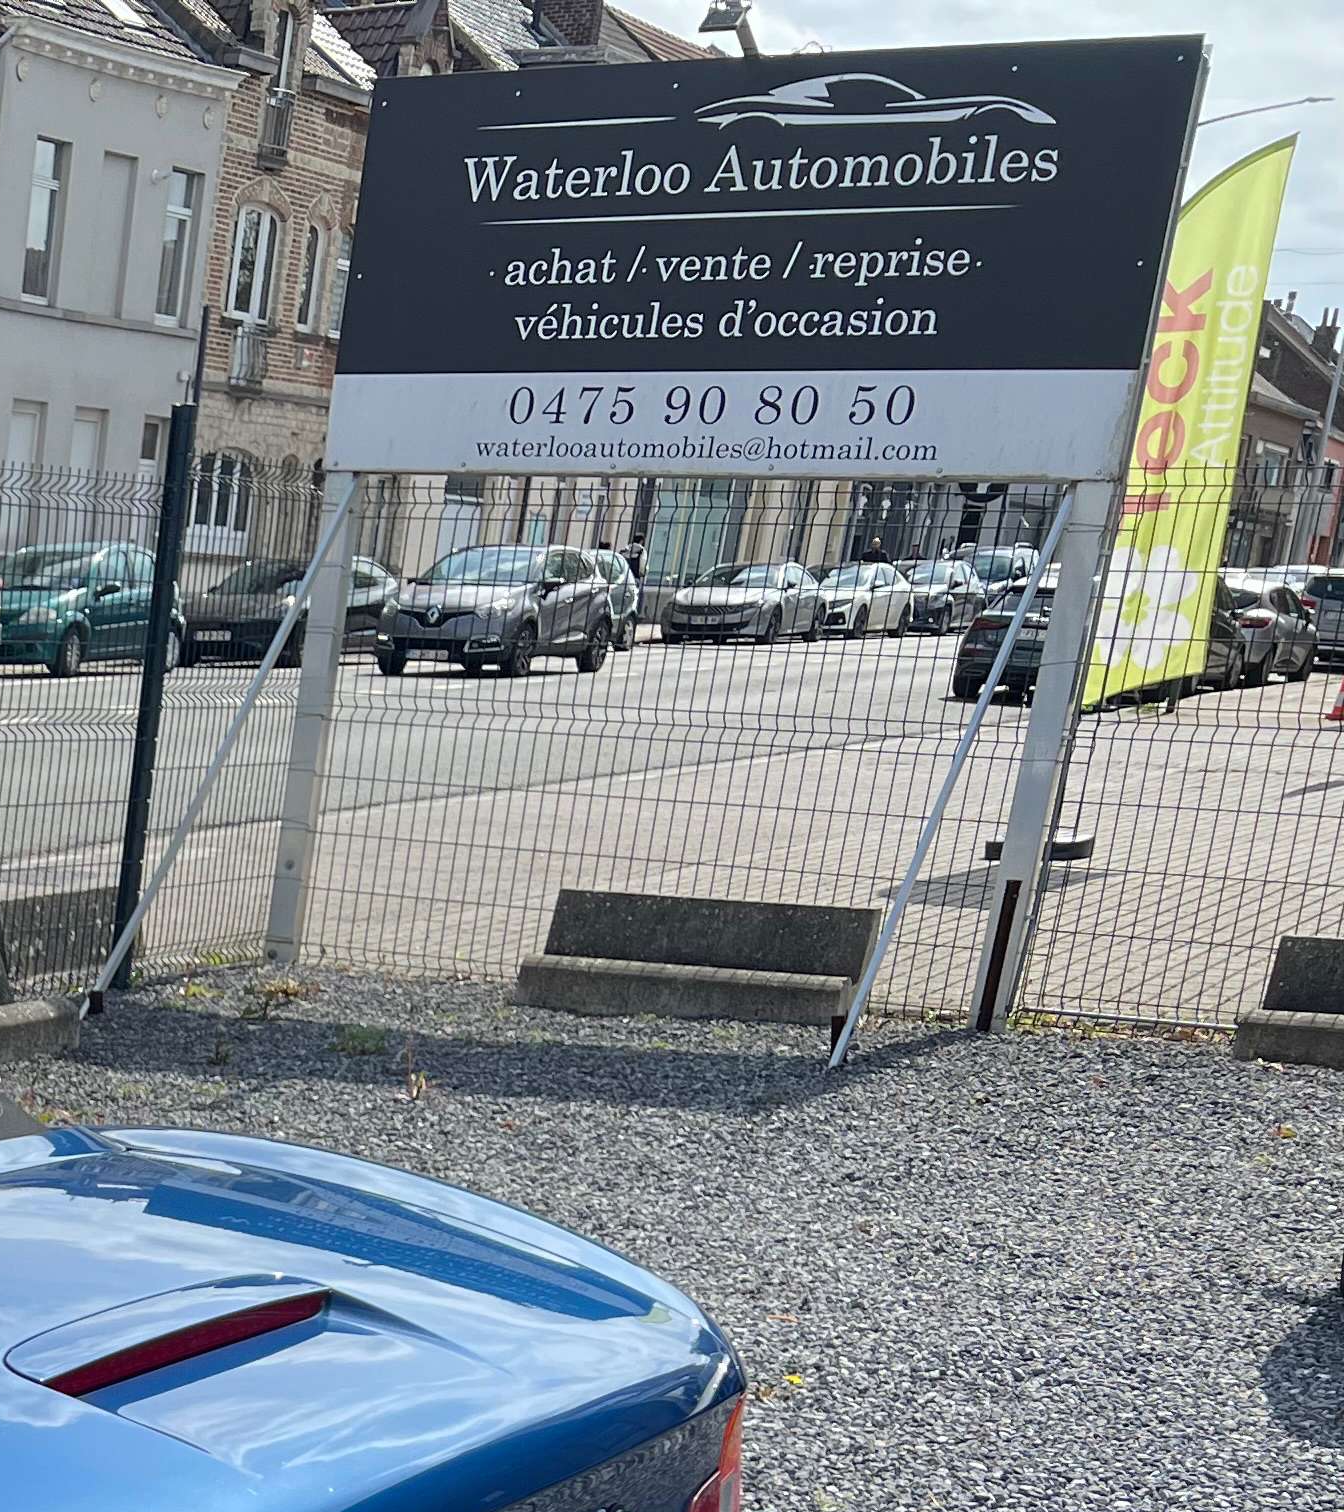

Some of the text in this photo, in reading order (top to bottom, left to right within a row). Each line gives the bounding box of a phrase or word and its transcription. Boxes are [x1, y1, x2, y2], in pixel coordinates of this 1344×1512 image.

[463, 133, 1060, 203] Waterloo Automobiles
[504, 237, 971, 287] achat / vente / reprise
[513, 301, 705, 341] véhicules
[1189, 264, 1259, 467] Attitude
[509, 385, 916, 425] 0475 90 80 50
[475, 434, 938, 462] waterlooautomobiles@hotmail.com
